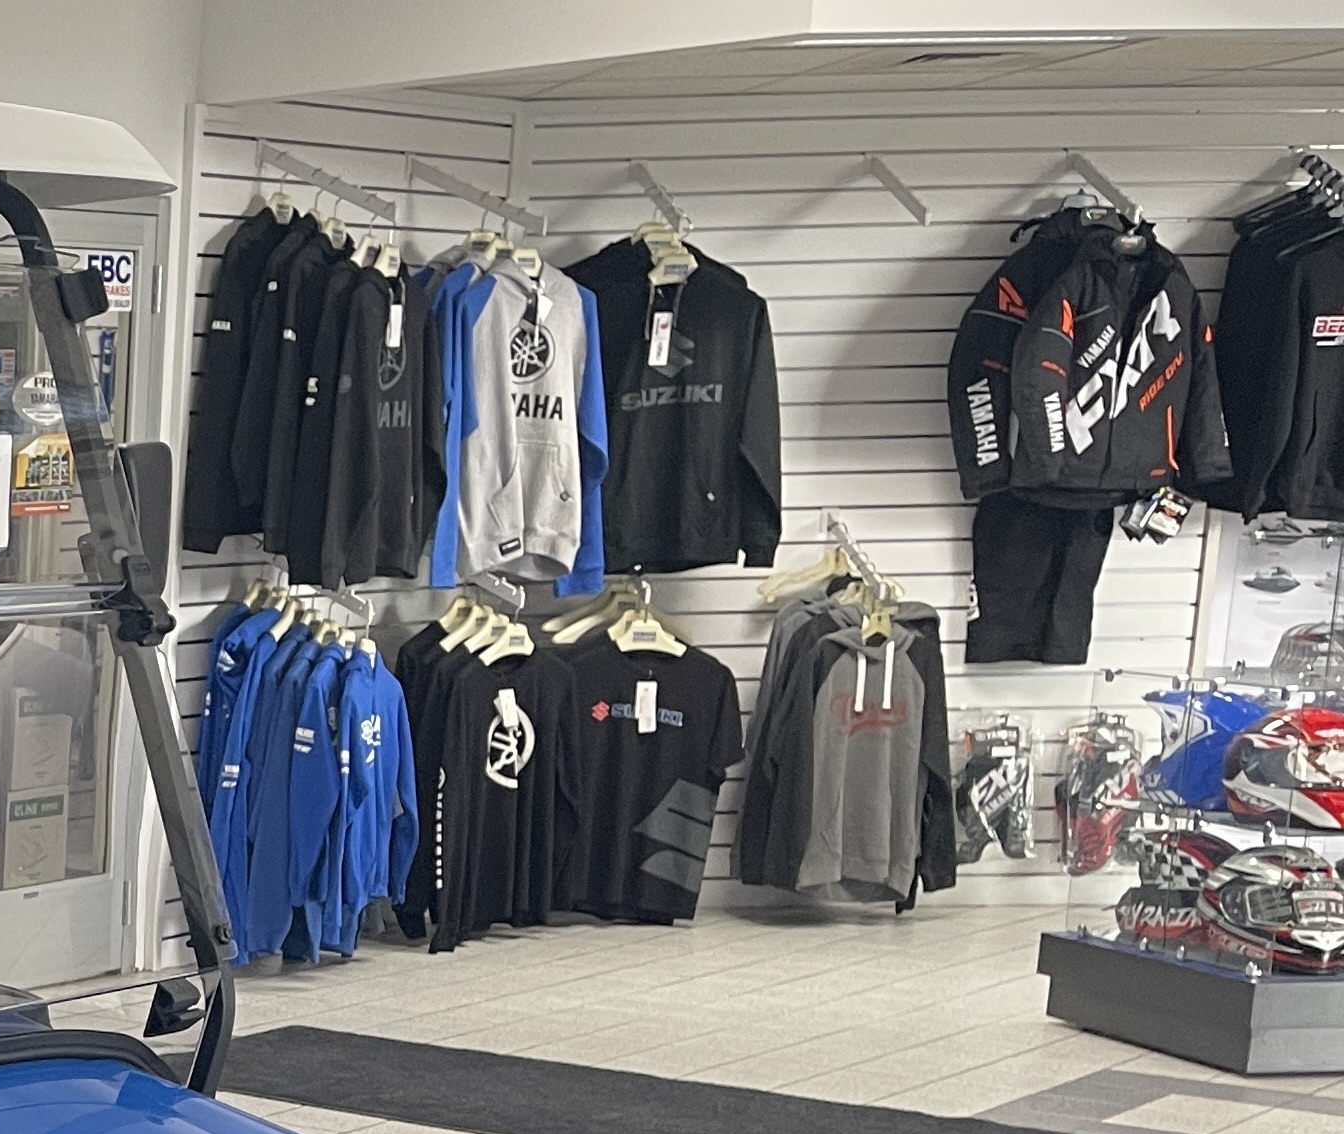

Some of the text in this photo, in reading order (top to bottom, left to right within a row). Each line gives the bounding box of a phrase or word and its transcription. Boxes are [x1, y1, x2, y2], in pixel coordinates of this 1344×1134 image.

[106, 286, 130, 297] RAKES
[1076, 323, 1116, 369] YAMAHA
[621, 383, 724, 411] SUZUKI
[966, 377, 1000, 468] YAMAHA
[1043, 391, 1066, 454] YAMAHA
[612, 703, 683, 727] SUKI
